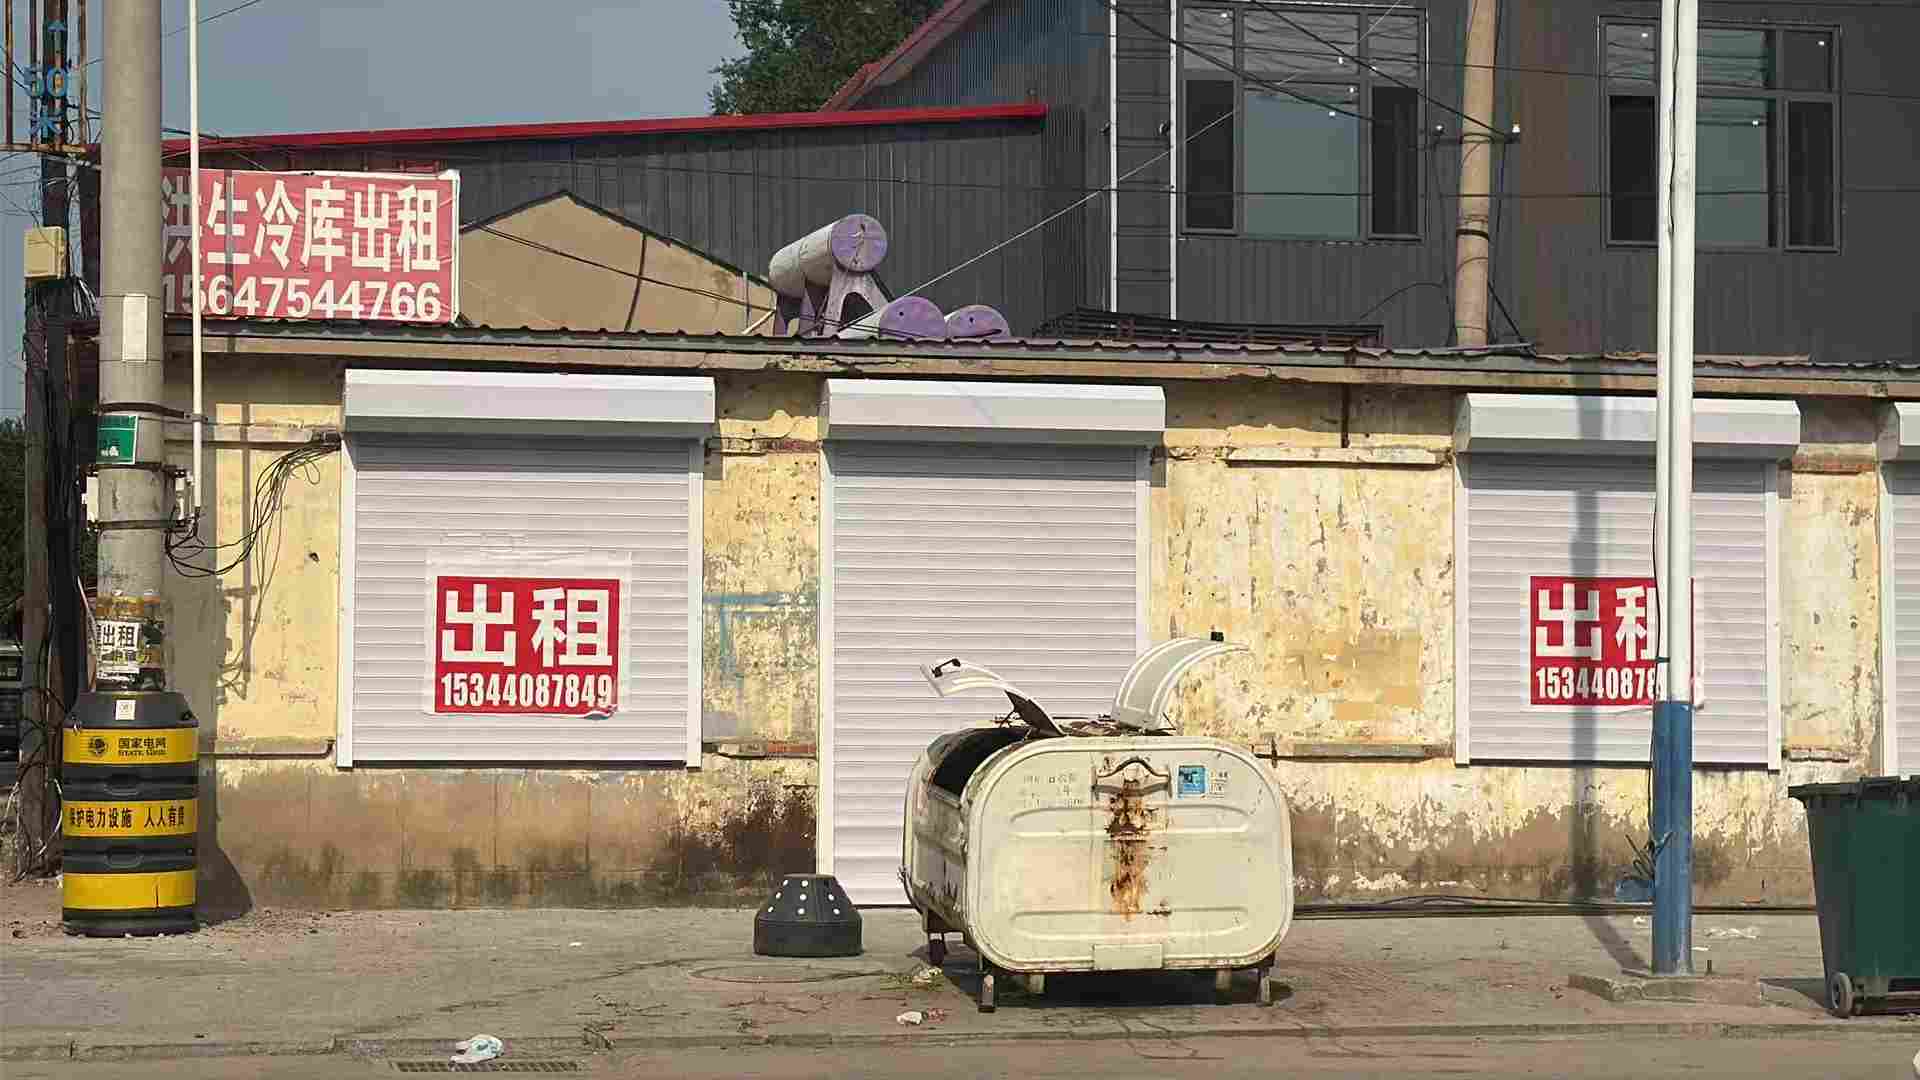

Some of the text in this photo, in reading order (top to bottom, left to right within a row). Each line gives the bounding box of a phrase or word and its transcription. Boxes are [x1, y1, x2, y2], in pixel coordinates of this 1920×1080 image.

[161, 175, 441, 273] 洪生冷库出租
[162, 273, 441, 321] 15647544766
[441, 583, 613, 668] 出租
[441, 672, 613, 707] 15344087849
[118, 737, 167, 750] 国家电网
[70, 805, 185, 829] 保护电力设施 人人有责
